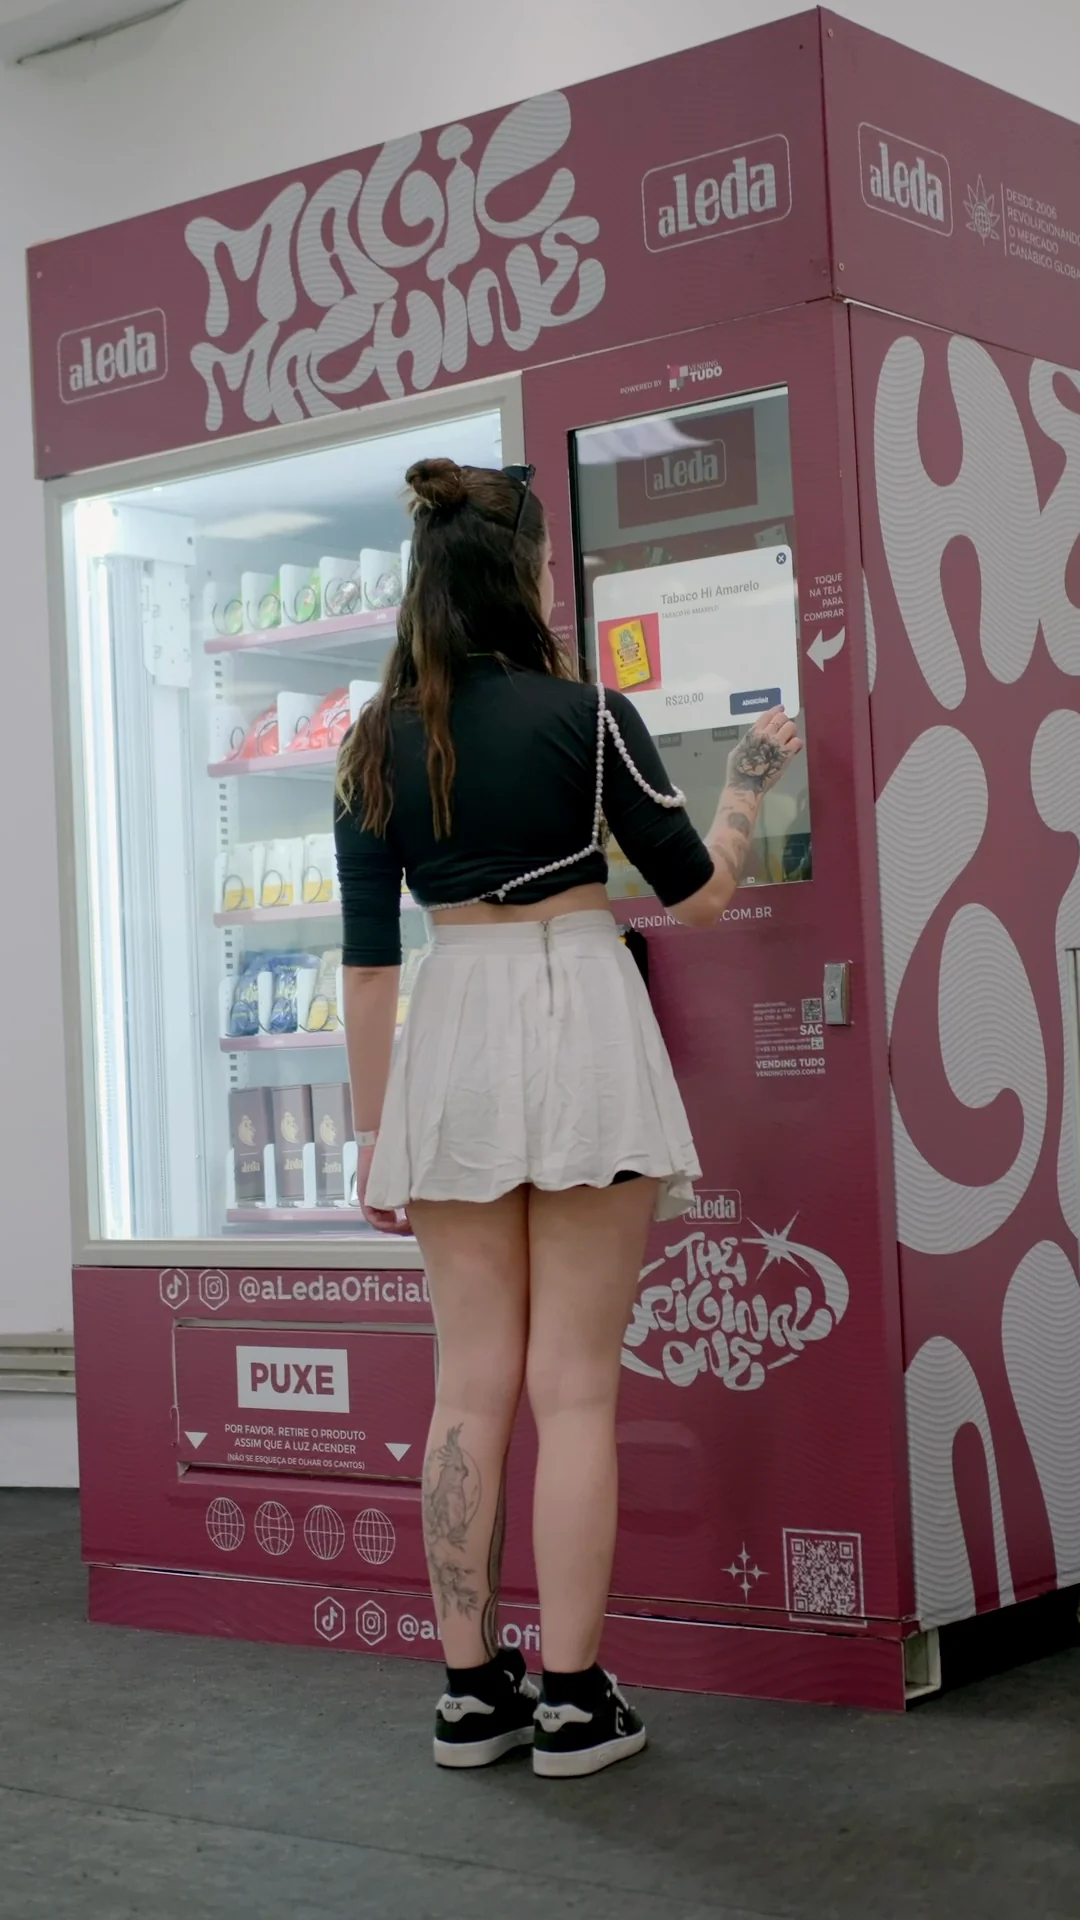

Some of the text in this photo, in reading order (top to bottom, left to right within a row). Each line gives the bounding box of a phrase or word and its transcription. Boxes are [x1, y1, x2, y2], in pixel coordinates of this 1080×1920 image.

[870, 141, 945, 222] aLeda
[658, 157, 777, 238] aLeda
[1006, 188, 1057, 220] DESDE 2006
[1008, 225, 1058, 255] O MERCADO
[69, 325, 157, 392] aLeda
[688, 360, 718, 372] VENDING
[689, 366, 722, 383] TUDO
[620, 380, 662, 394] POWERED BY
[814, 572, 842, 584] TOQUE
[660, 580, 759, 605] Tabaco Hi Amarelo
[809, 585, 843, 597] NA TELA
[822, 596, 844, 608] PARA
[803, 608, 844, 622] COMPRAR
[800, 1024, 823, 1036] SAC
[756, 1057, 825, 1069] VENDING TUDO
[664, 1231, 747, 1287] THE
[239, 1275, 430, 1303] @aLedaOficial
[250, 1362, 335, 1396] PUXE
[224, 1423, 243, 1434] POR
[278, 1426, 309, 1438] RETIRE
[311, 1428, 318, 1438] O
[320, 1429, 366, 1441] PRODUTO
[234, 1438, 357, 1455] ASSIM QUE A LUZ ACENDER
[227, 1452, 245, 1462] (NÃO
[255, 1456, 286, 1465] ESQUEÇA
[287, 1457, 297, 1465] DE
[298, 1458, 322, 1467] OLHAR
[323, 1460, 333, 1468] OS
[334, 1460, 365, 1470] CANTOS)
